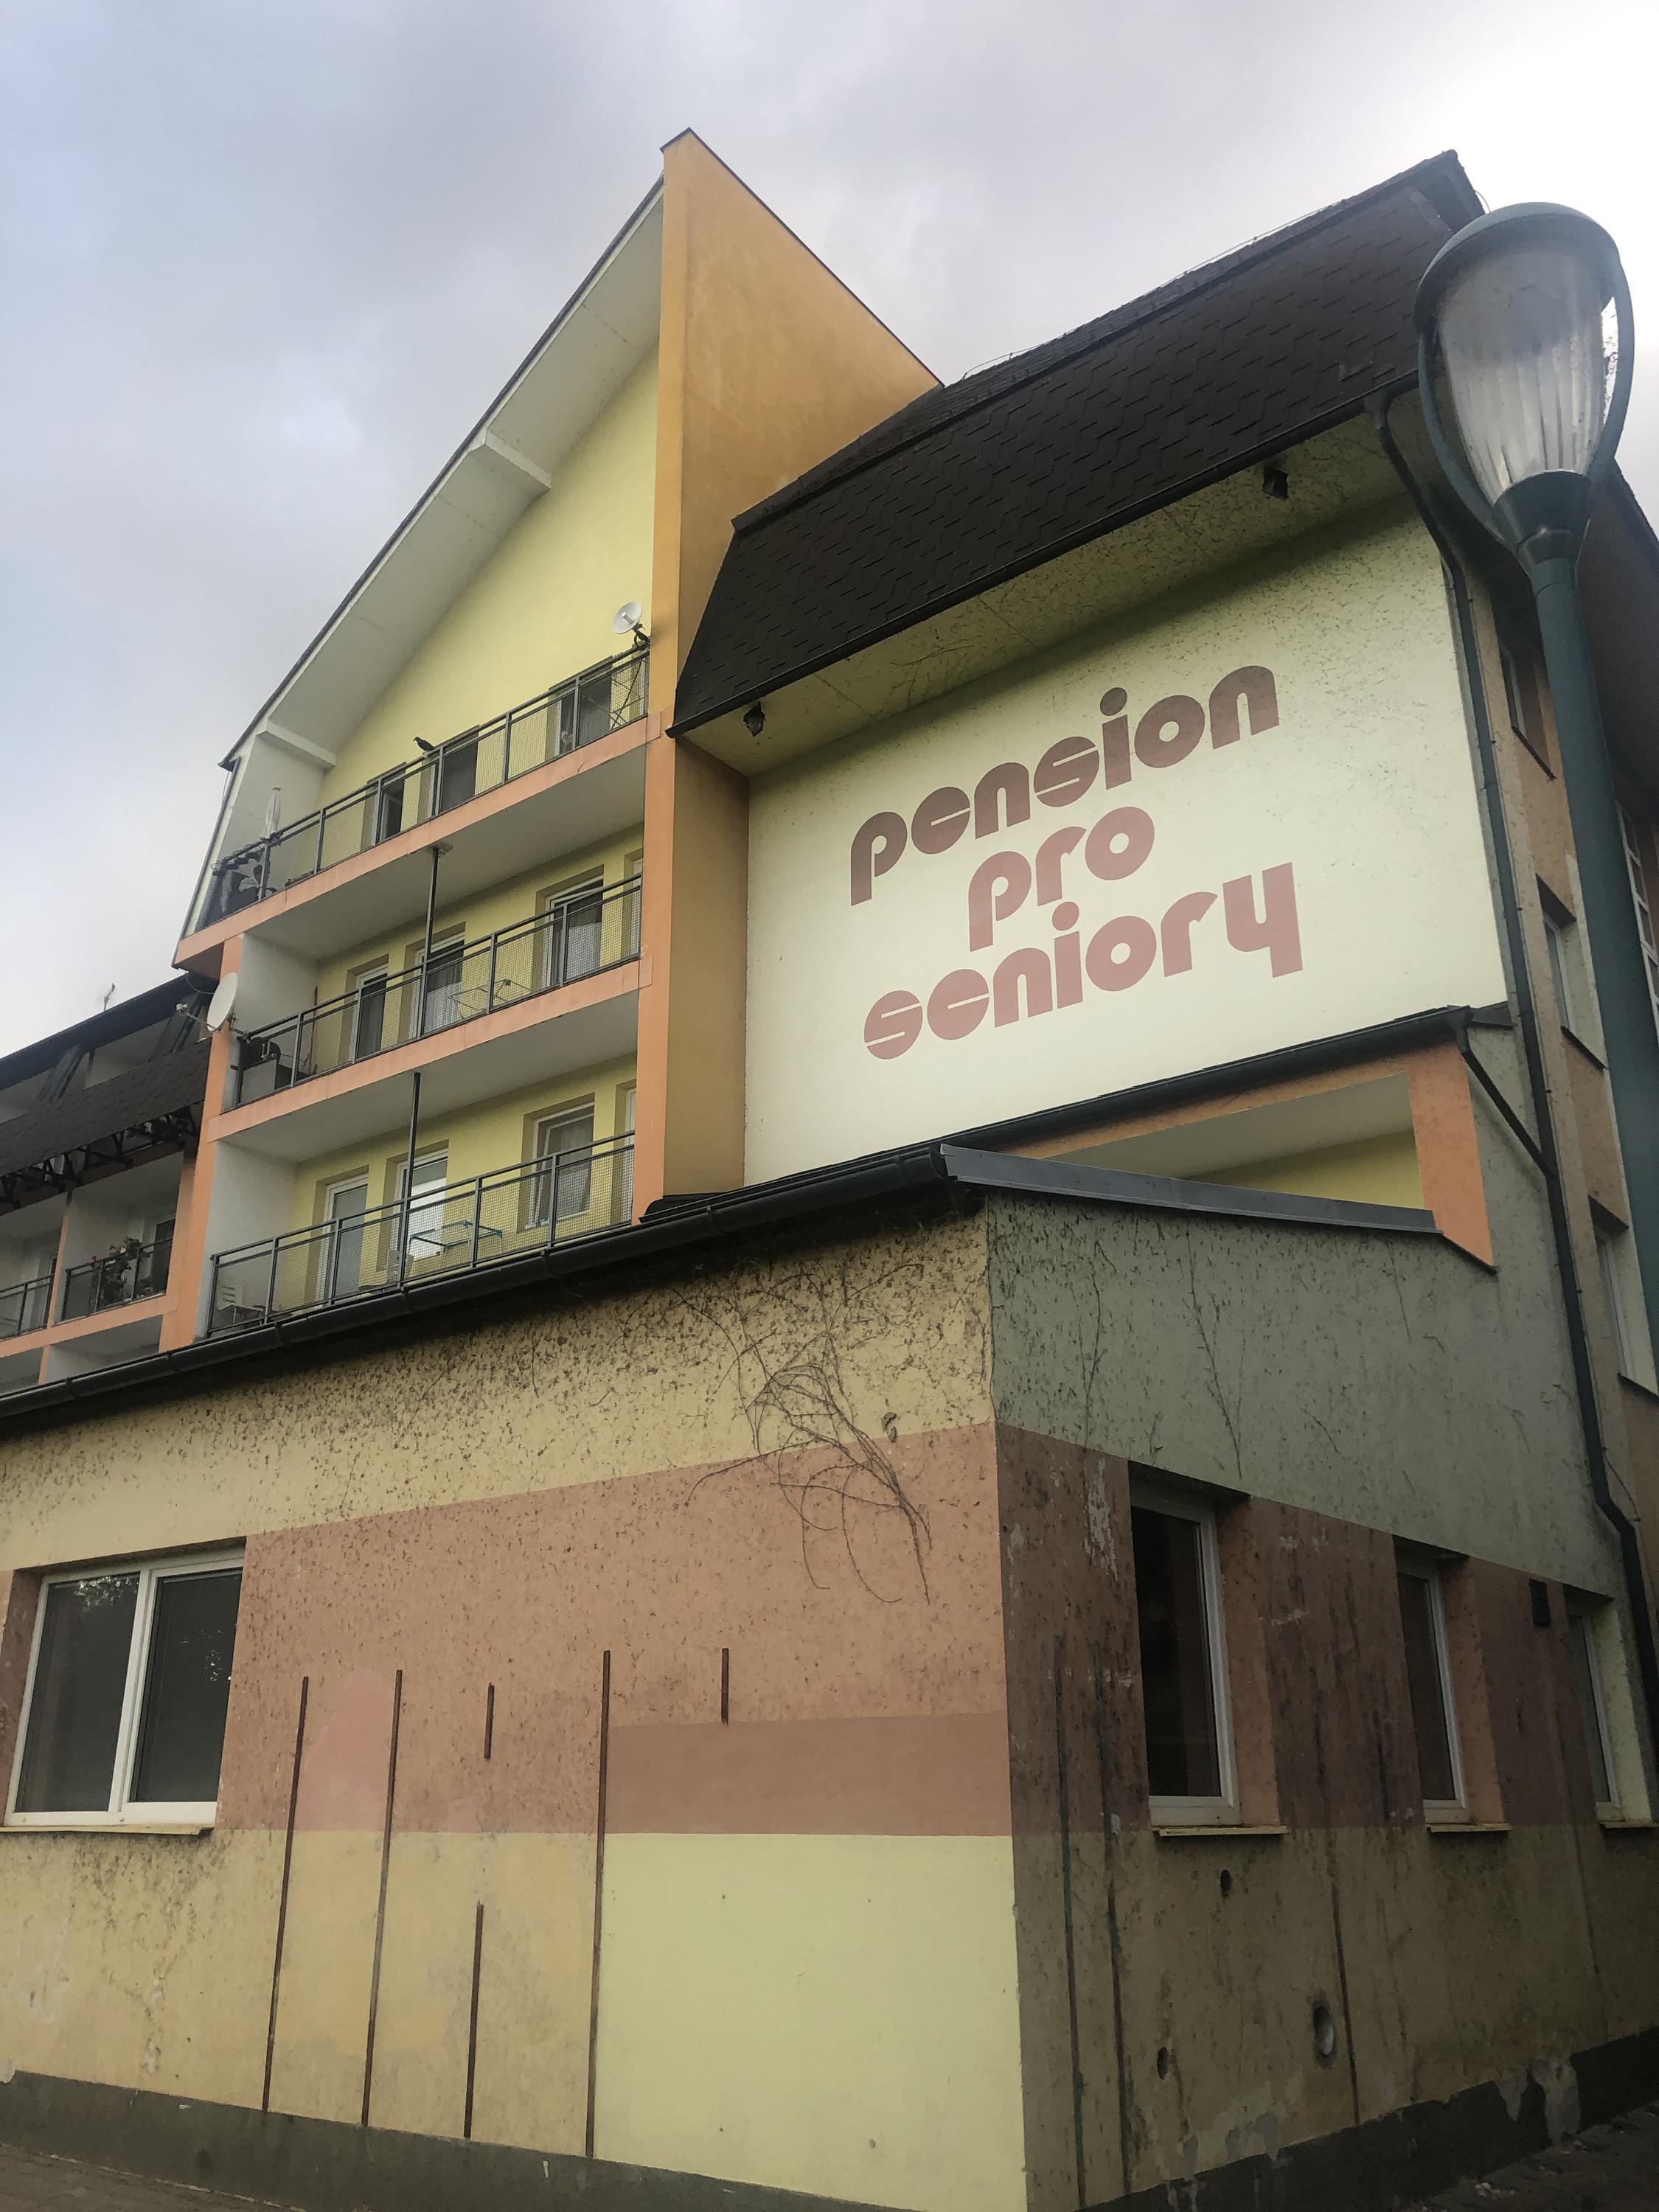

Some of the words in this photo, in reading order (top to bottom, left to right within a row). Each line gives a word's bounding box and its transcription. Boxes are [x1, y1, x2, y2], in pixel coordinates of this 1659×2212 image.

[851, 665, 1279, 906] pension
[968, 806, 1155, 952] pro
[863, 861, 1303, 1060] seniory
